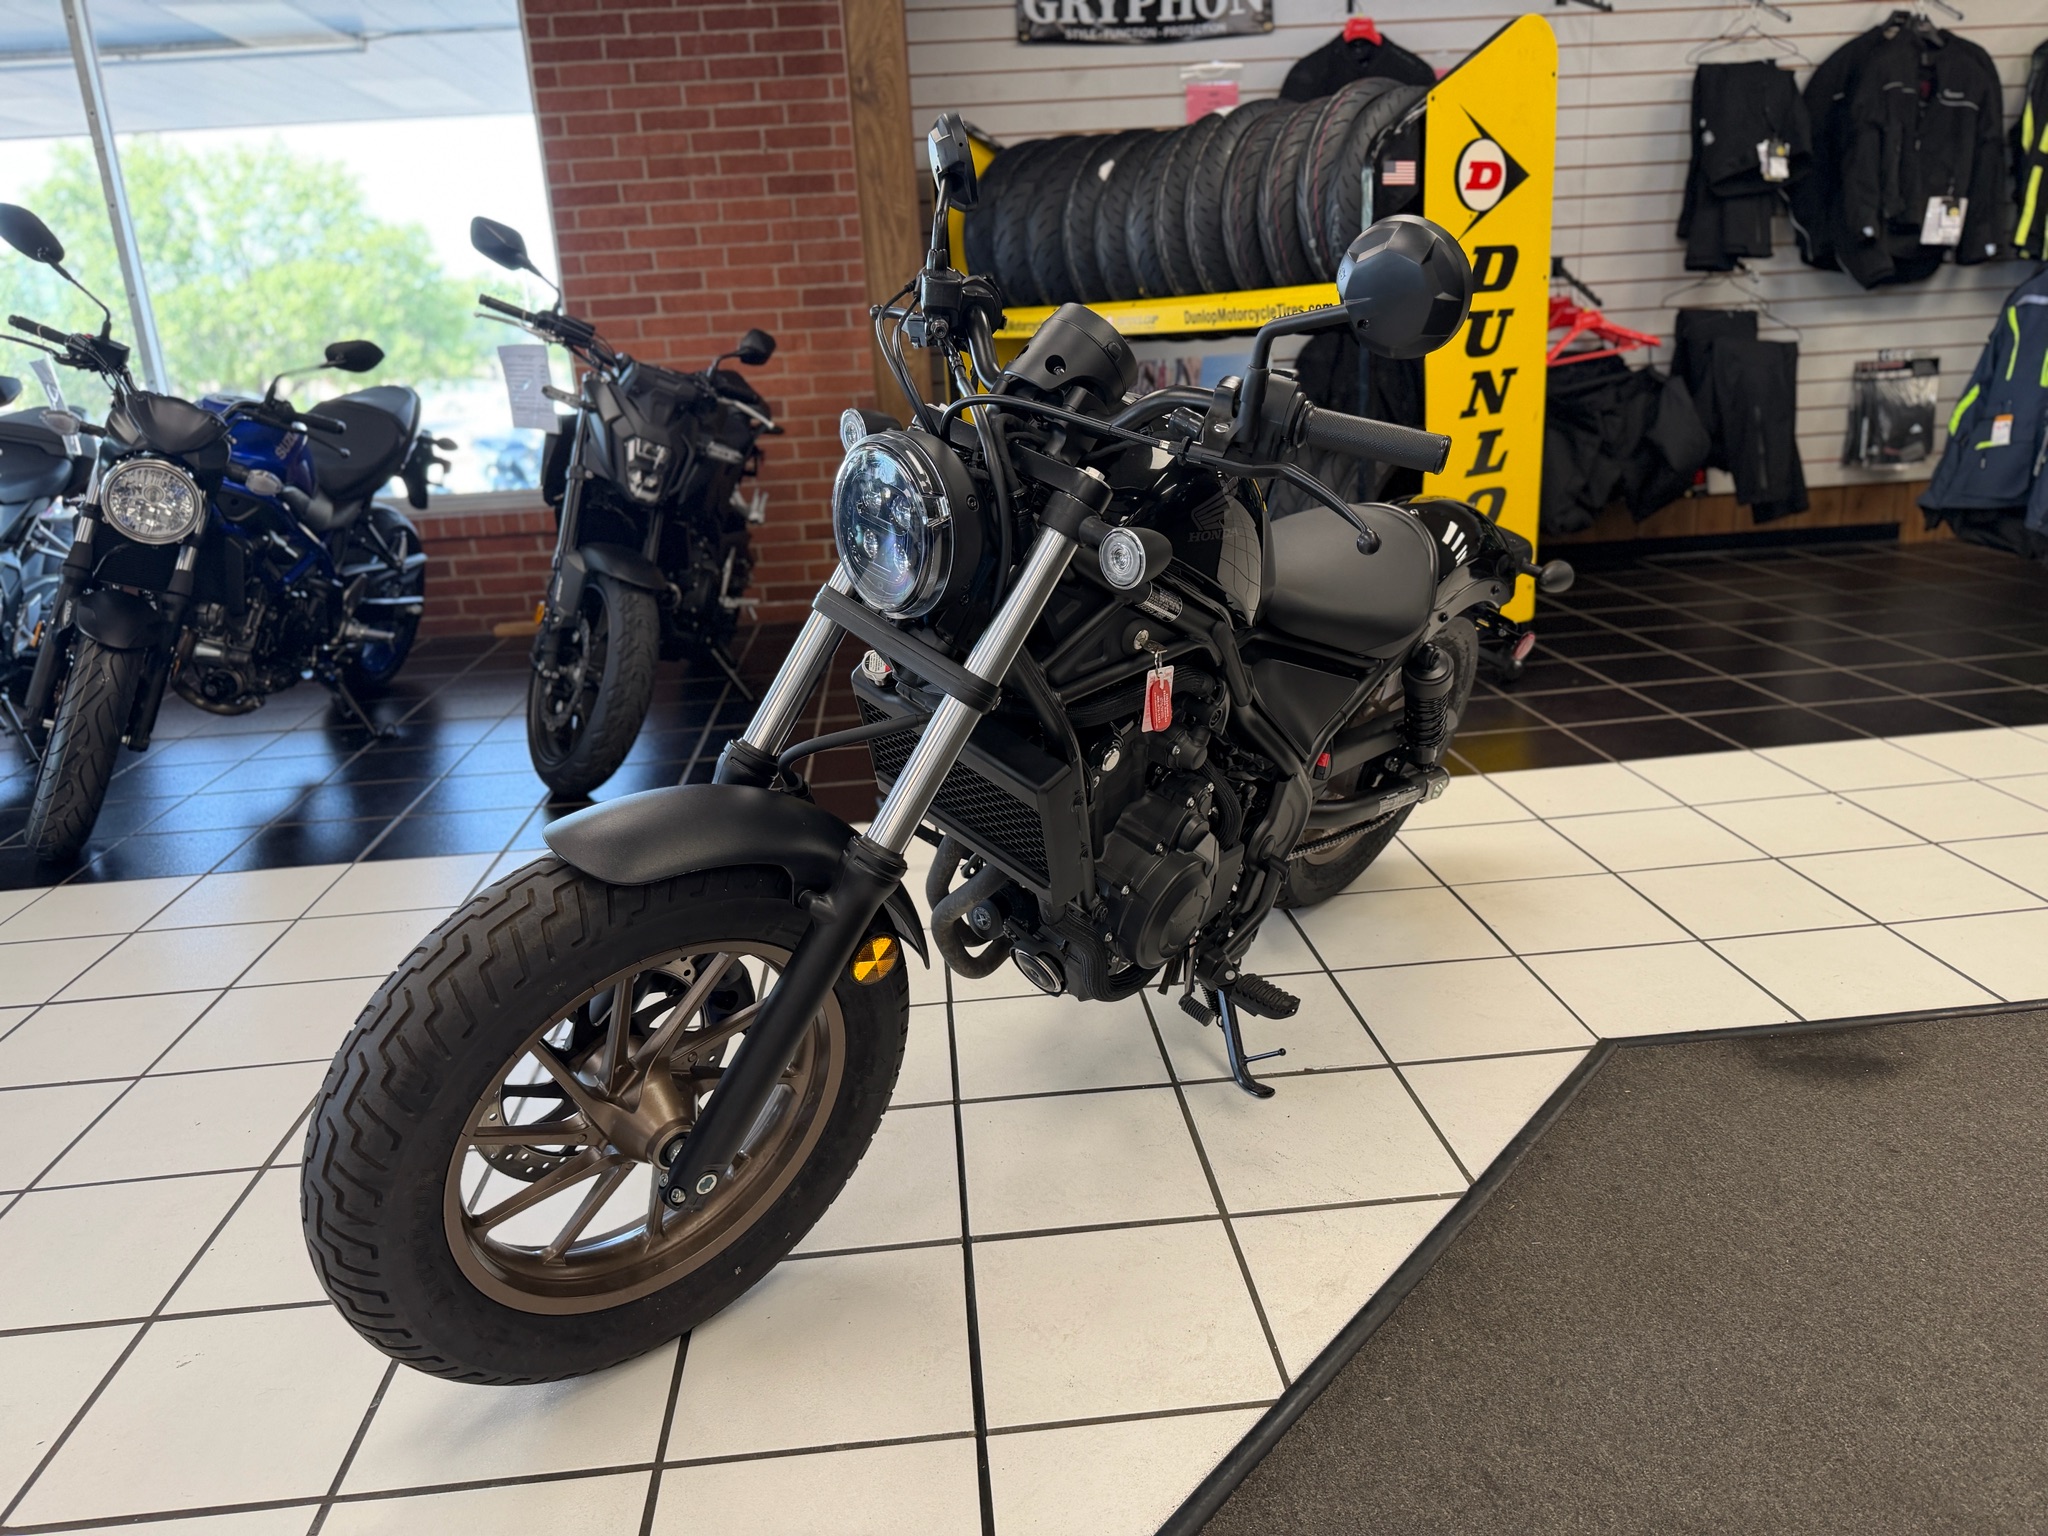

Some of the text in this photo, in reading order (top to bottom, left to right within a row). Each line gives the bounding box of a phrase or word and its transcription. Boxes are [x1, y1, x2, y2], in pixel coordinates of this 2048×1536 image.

[1103, 26, 1158, 39] FUNCTION
[1163, 22, 1228, 37] PROTECTION
[1465, 161, 1503, 190] D
[1184, 303, 1333, 325] DunlopMotorcycleTiresco
[1459, 244, 1519, 525] DUNLO
[275, 431, 299, 460] SUZ
[1187, 527, 1239, 542] HONDA
